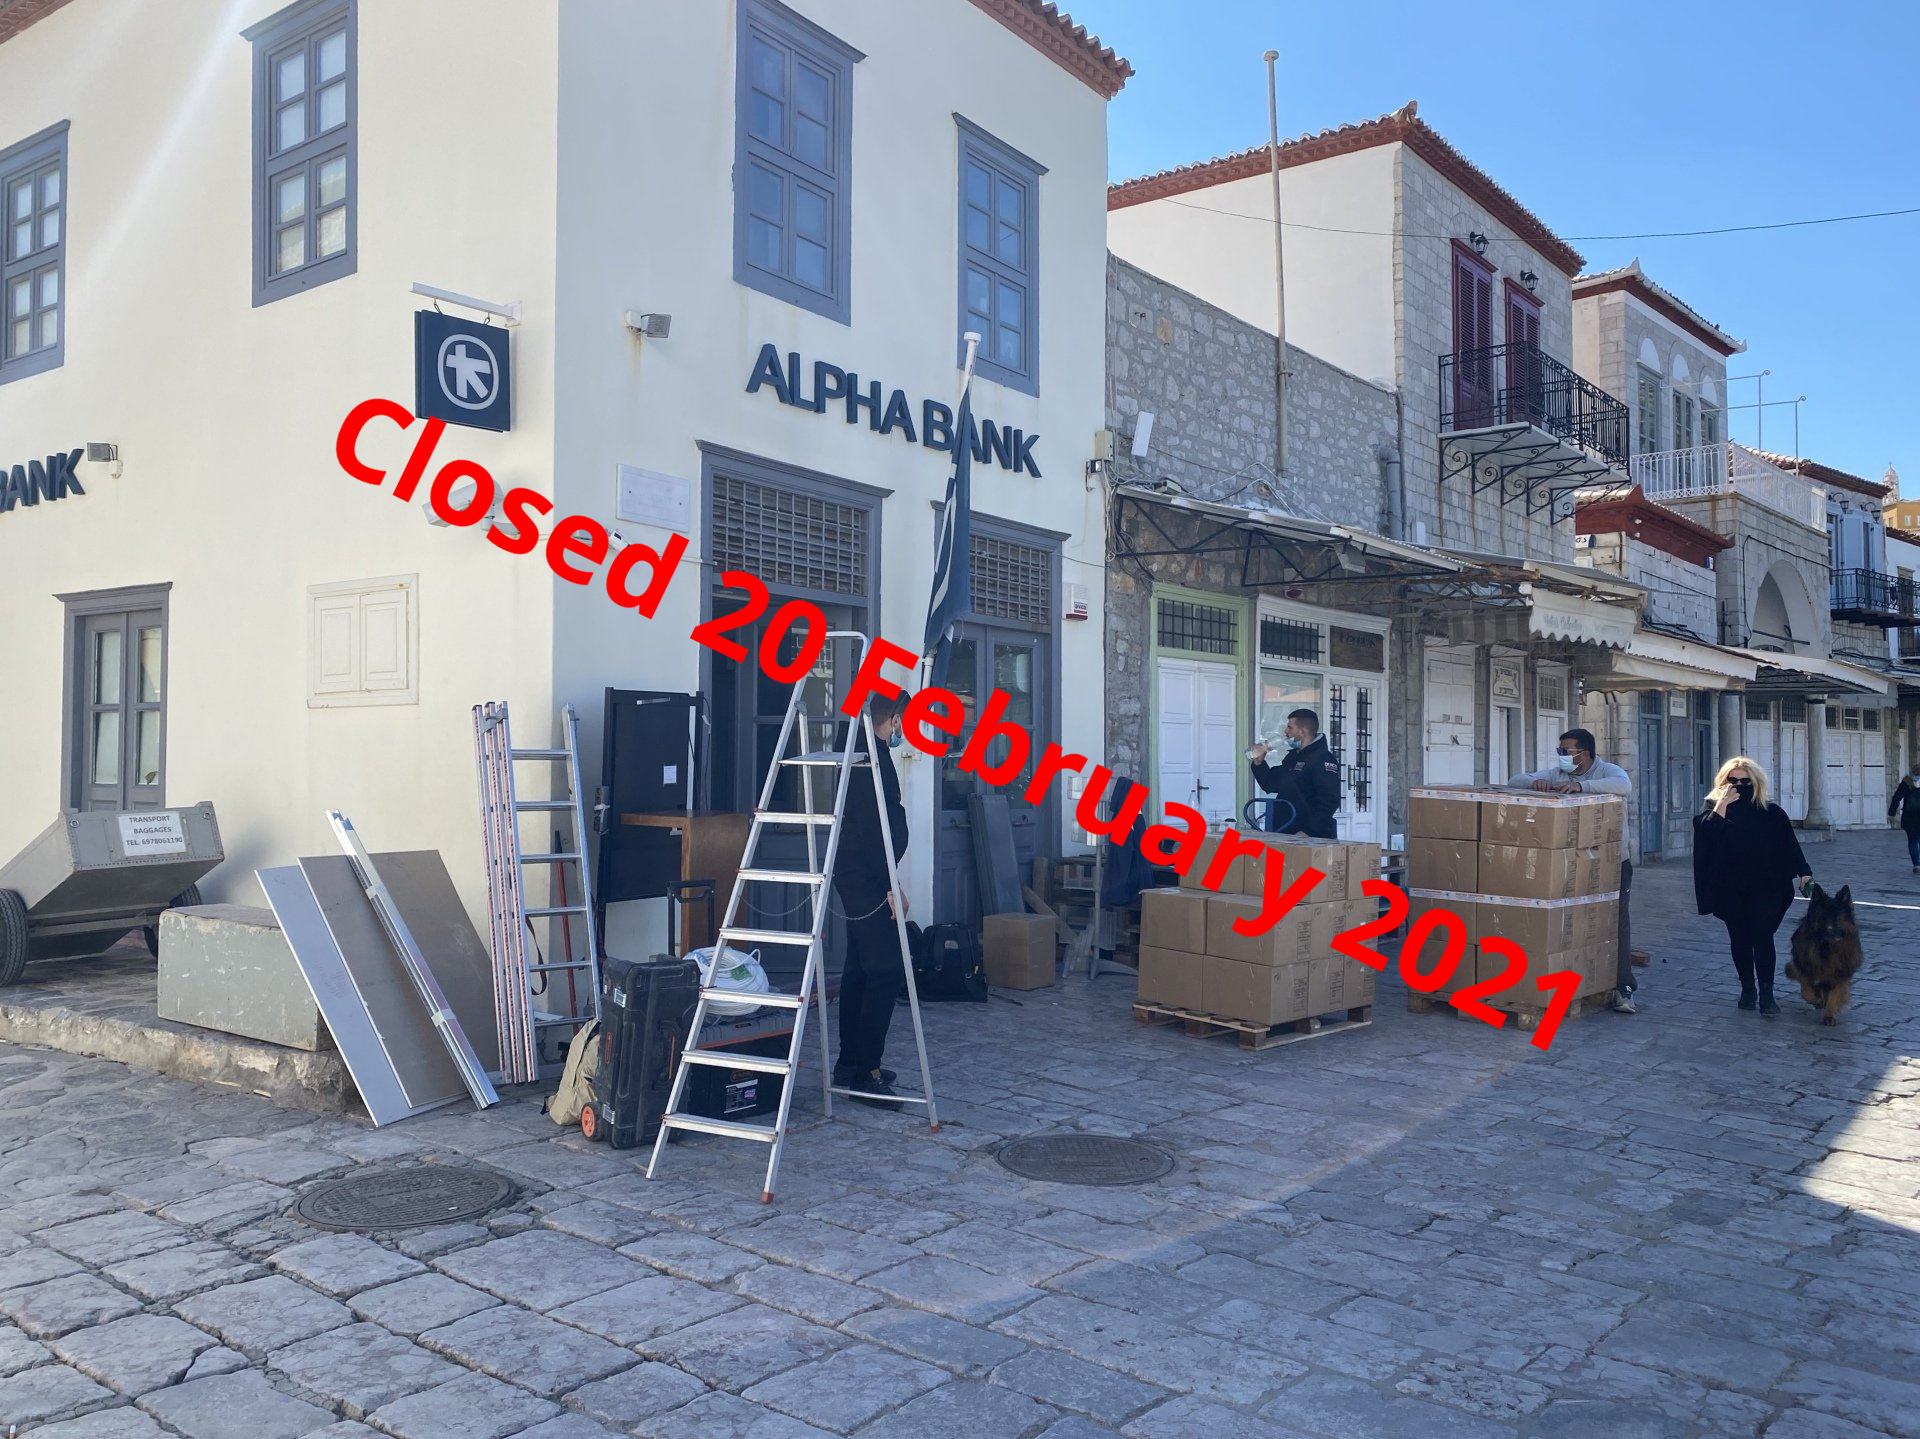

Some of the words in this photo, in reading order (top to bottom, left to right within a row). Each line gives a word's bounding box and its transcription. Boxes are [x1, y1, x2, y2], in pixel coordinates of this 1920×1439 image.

[746, 343, 917, 442] ALPHA
[129, 815, 171, 823] TRANSPORT
[133, 826, 172, 834] BAGGAGES
